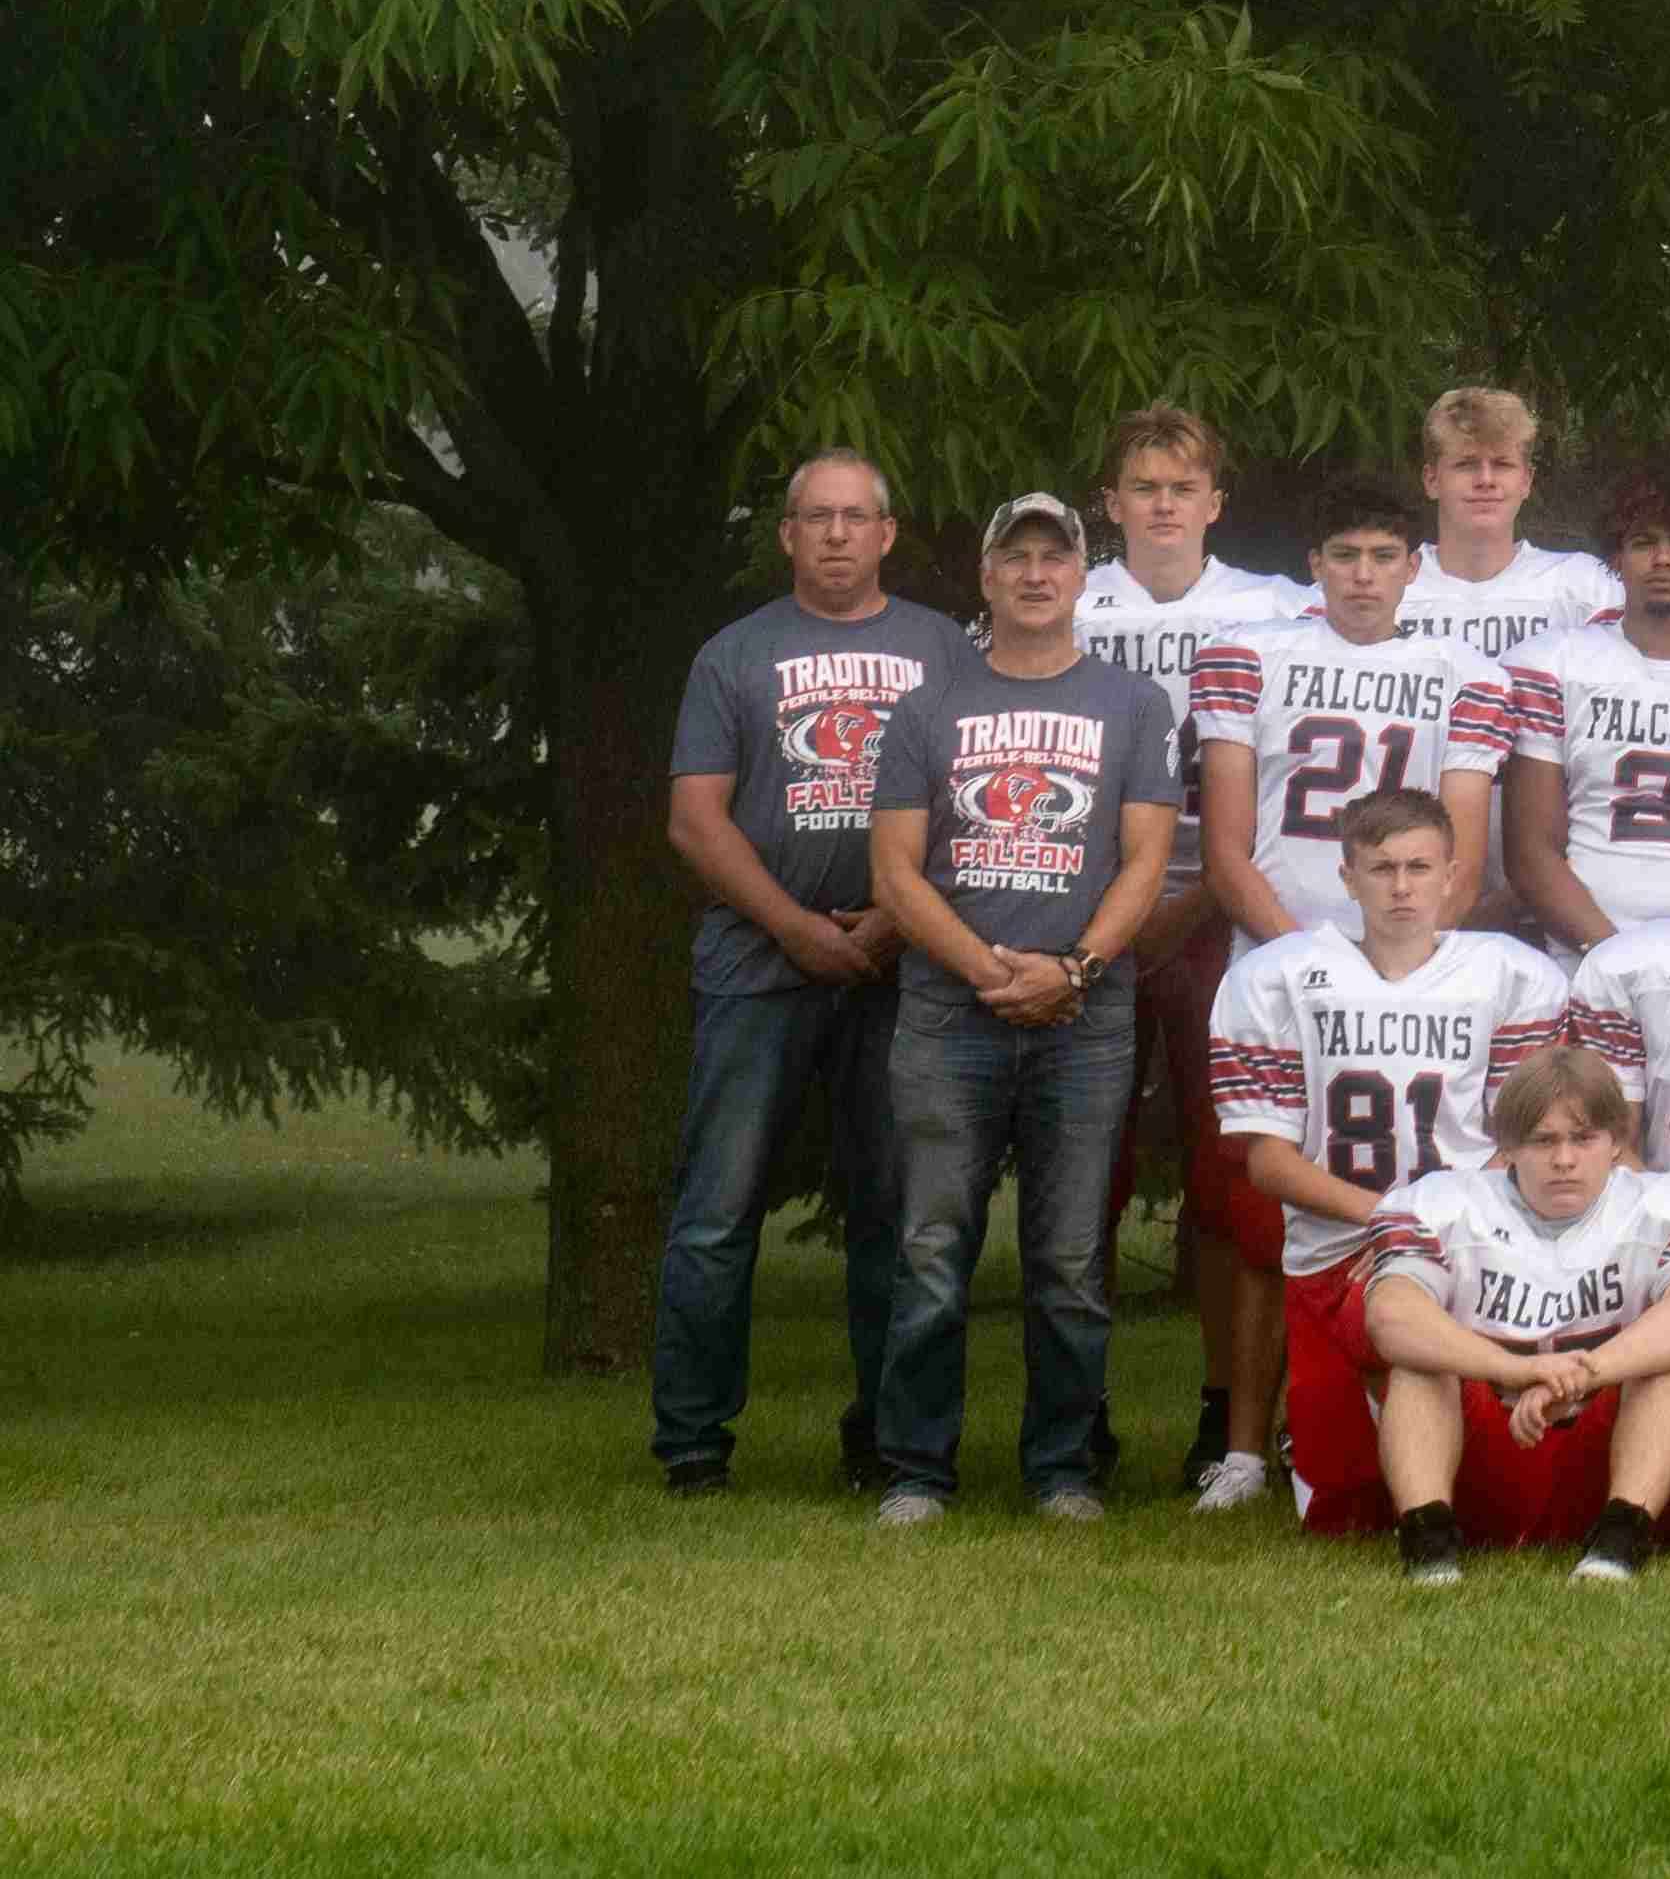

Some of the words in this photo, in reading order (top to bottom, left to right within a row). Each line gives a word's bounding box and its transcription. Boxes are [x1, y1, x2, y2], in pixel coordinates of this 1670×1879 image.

[775, 652, 924, 698] TRADITION
[1088, 632, 1212, 679] FALCO
[777, 687, 900, 714] FERTILE-BELTR
[1283, 664, 1444, 723] FALCONS
[956, 710, 1105, 761] TRADITION
[785, 779, 877, 814] FALC
[1280, 715, 1417, 842] 21
[794, 810, 873, 832] FOOTB
[950, 837, 1085, 876] FALCON
[955, 869, 1071, 894] FOOTBALL
[1311, 1009, 1473, 1062] FALCONS
[1325, 1069, 1453, 1196] 81
[1473, 1261, 1625, 1329] FALCONS
